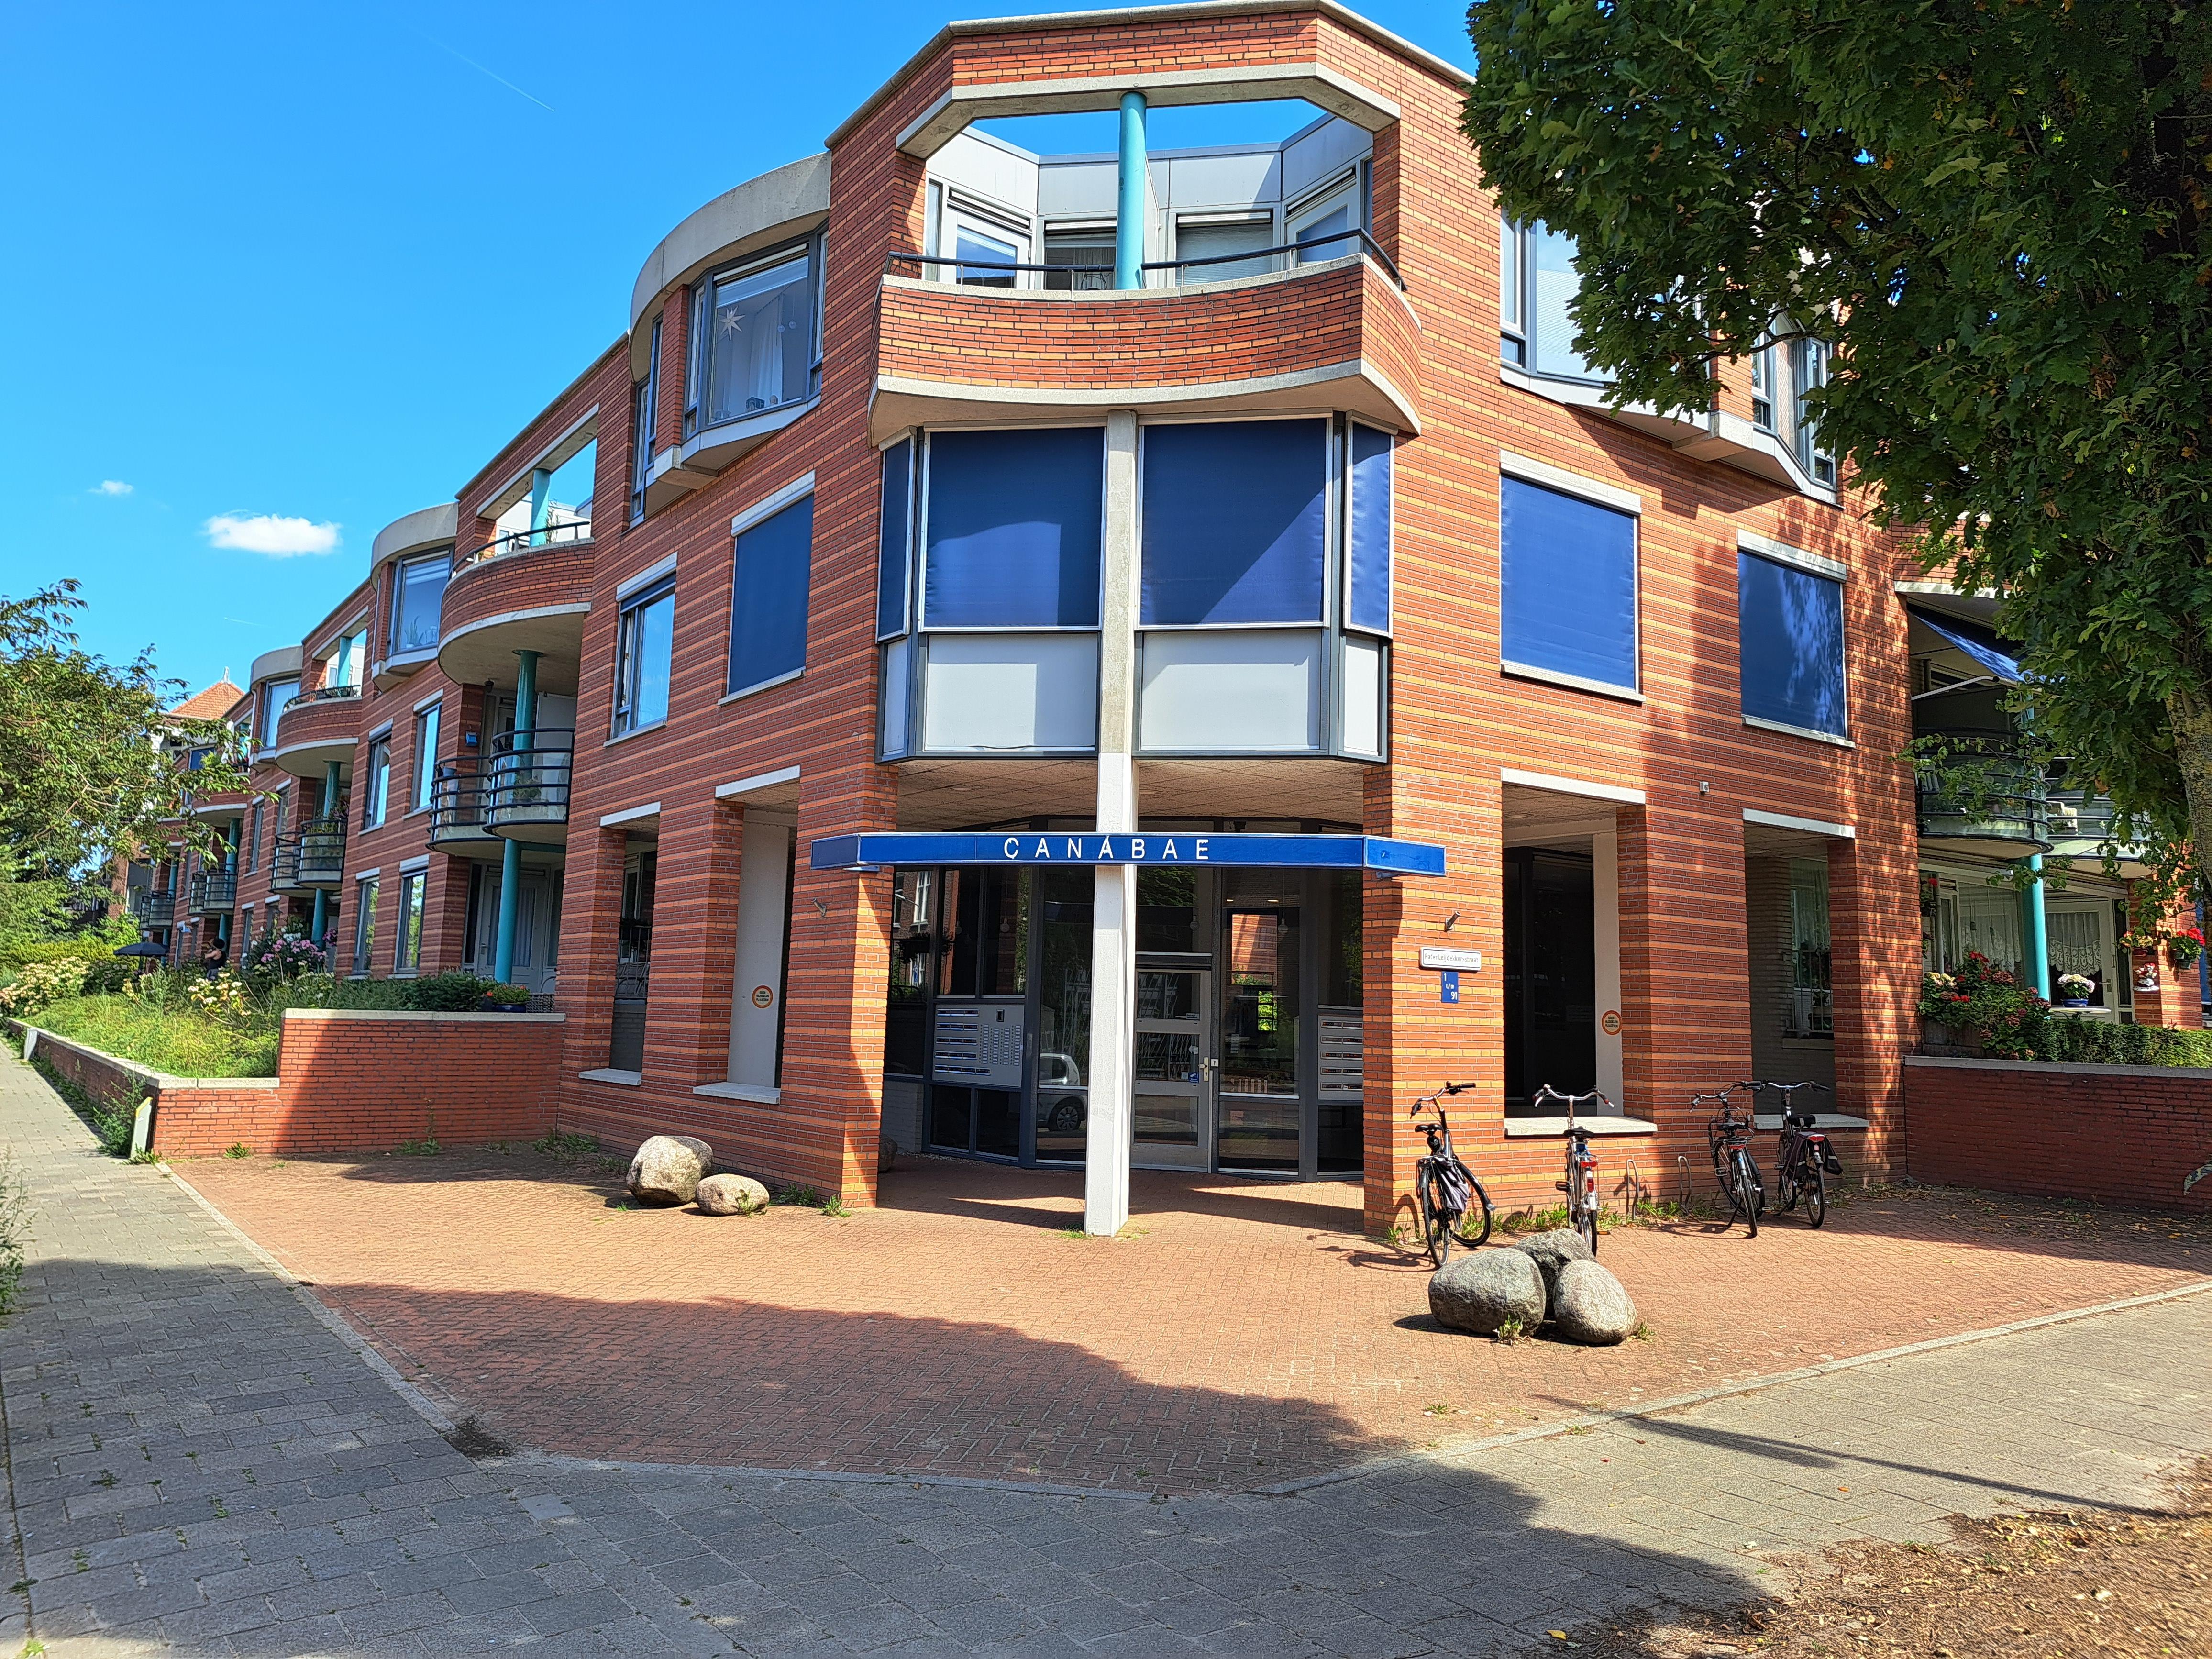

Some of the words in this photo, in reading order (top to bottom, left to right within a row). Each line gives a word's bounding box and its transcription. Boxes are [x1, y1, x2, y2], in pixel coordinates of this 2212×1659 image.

[1004, 837, 1209, 860] CANABAE
[1438, 954, 1479, 963] Leijdekkersstraat
[1444, 973, 1447, 981] 1
[1451, 991, 1457, 1000] 91
